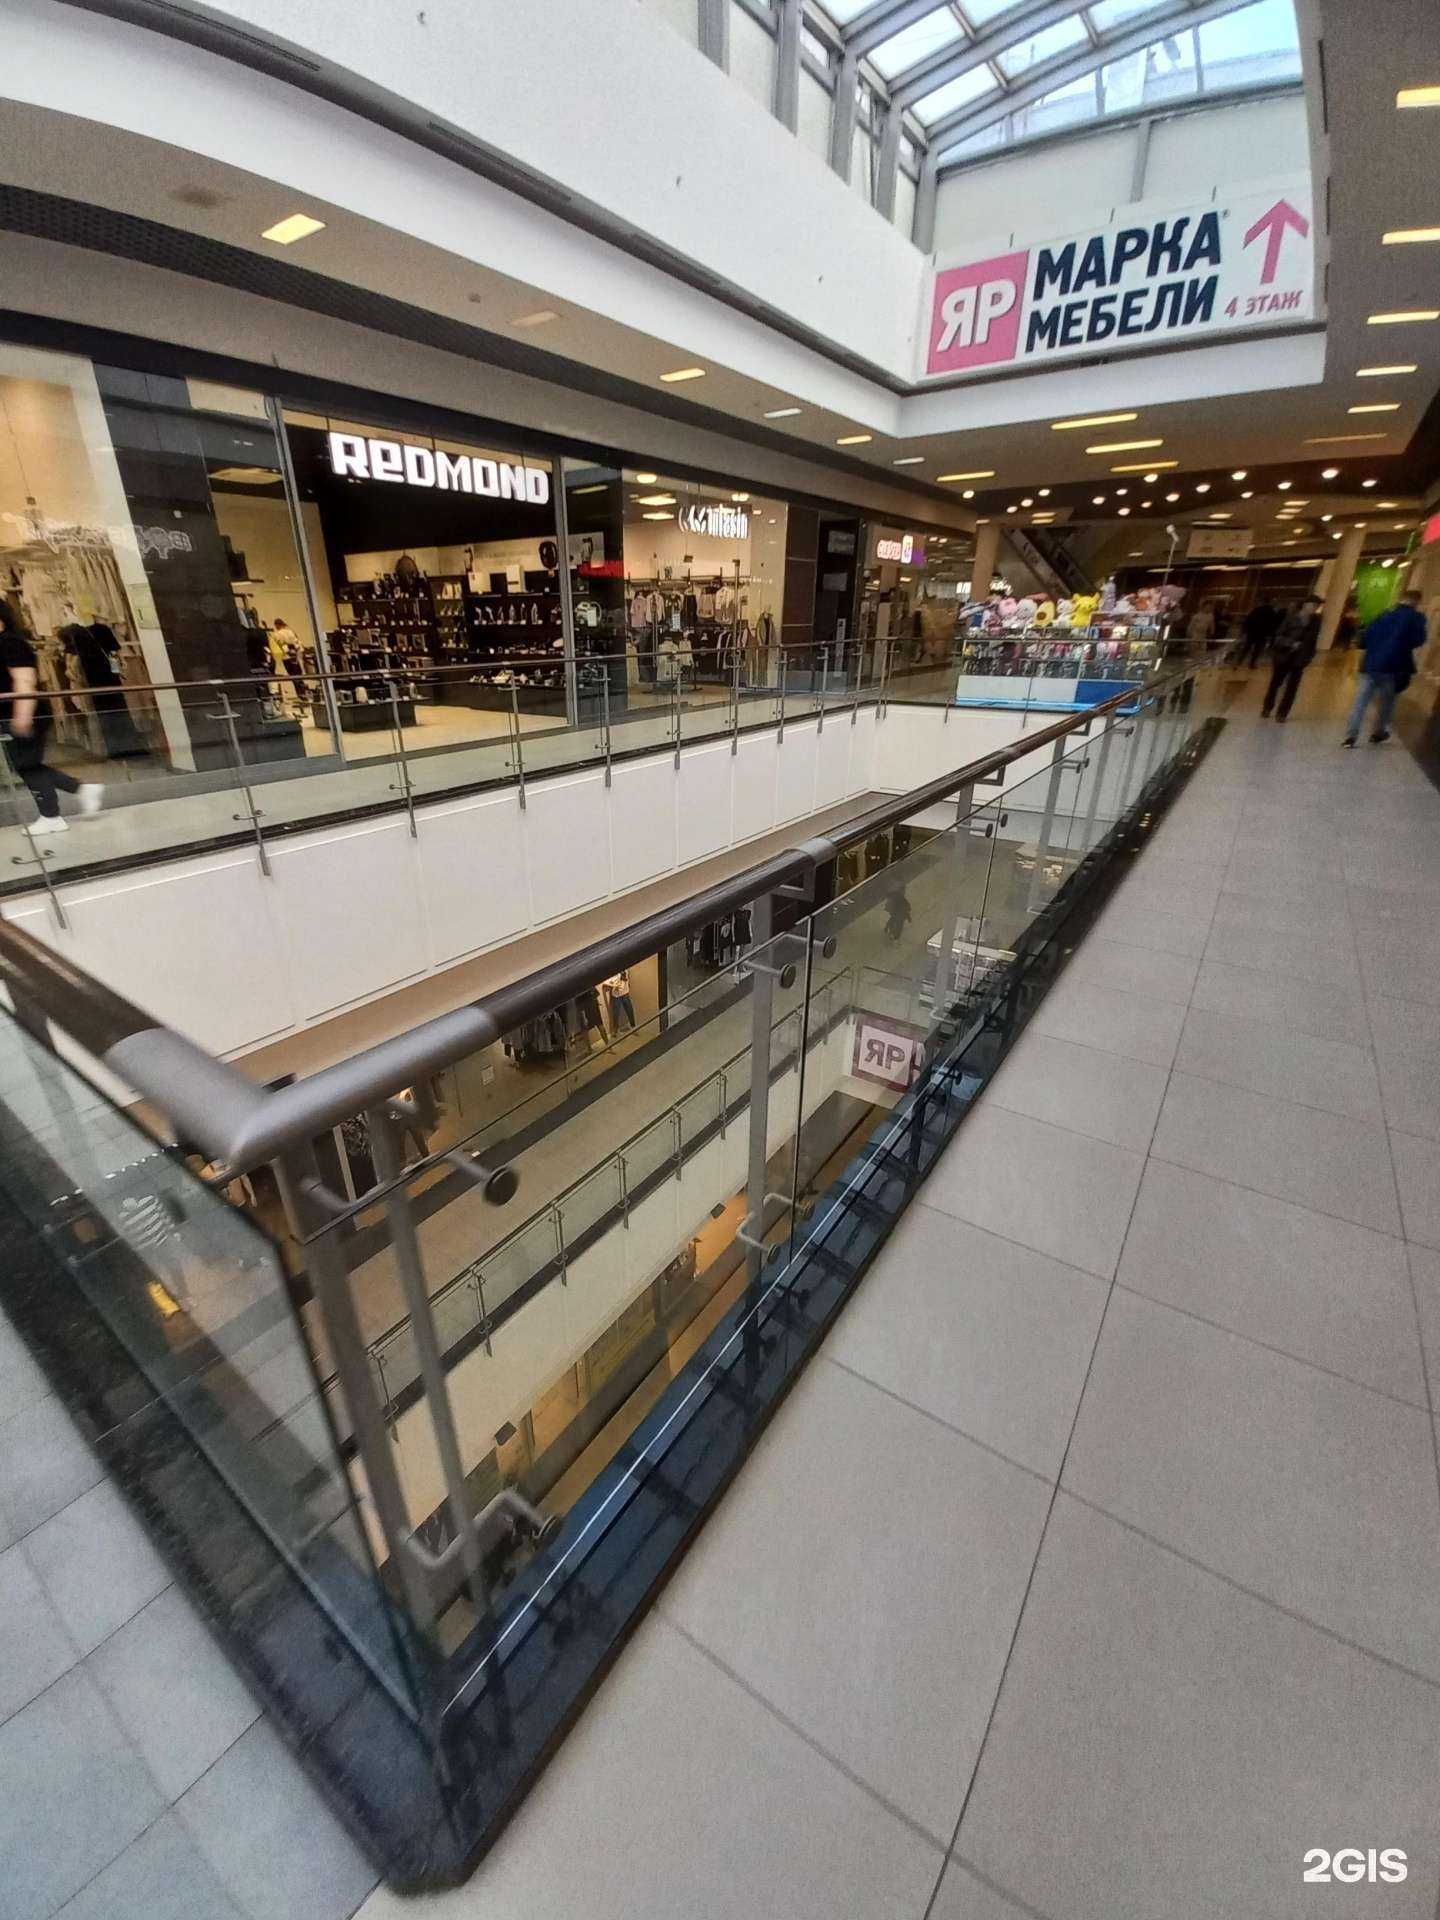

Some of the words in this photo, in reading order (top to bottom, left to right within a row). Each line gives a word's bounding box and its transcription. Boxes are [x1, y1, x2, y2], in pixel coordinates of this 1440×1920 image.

[1033, 209, 1222, 301] МАРКА
[936, 278, 1018, 353] ЯР
[1024, 274, 1219, 354] МЕБЕЛИ
[1223, 295, 1238, 319] 4
[1245, 289, 1304, 317] ЭТАЖ
[864, 1038, 906, 1070] ЯР
